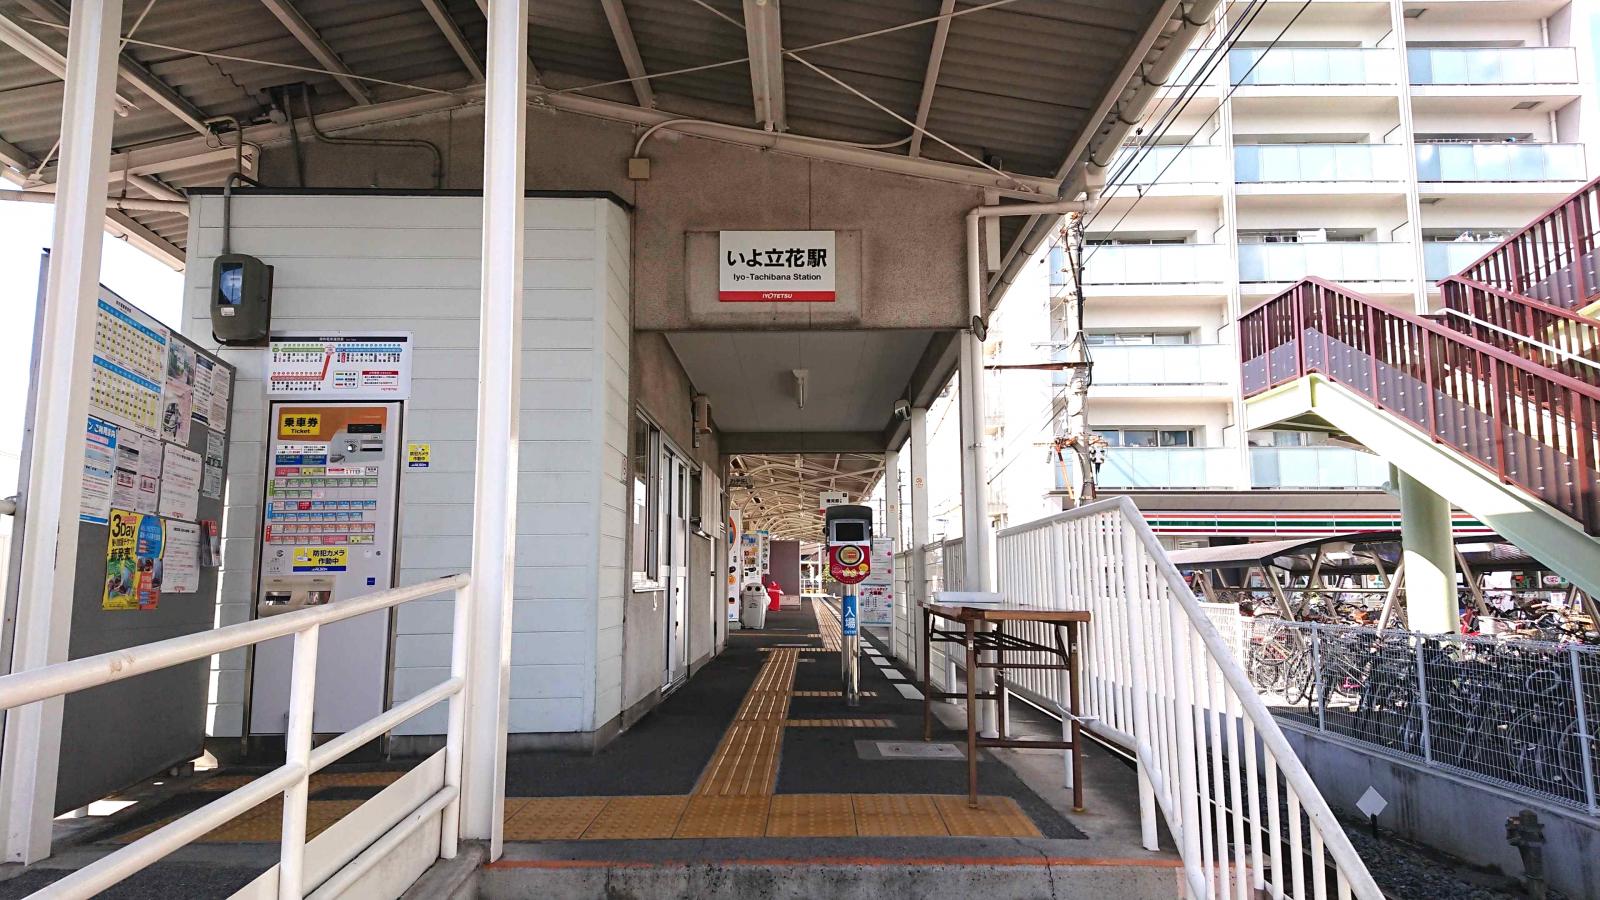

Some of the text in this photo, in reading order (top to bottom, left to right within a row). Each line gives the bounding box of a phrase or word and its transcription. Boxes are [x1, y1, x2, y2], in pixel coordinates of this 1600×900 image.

[727, 248, 827, 268] いよ立花駅
[733, 273, 822, 282] Iyo-Tachibana Station
[284, 417, 319, 428] 乗車券
[312, 549, 346, 557] 防犯カメラ
[318, 557, 339, 565] 作動中
[844, 606, 856, 629] 入場
